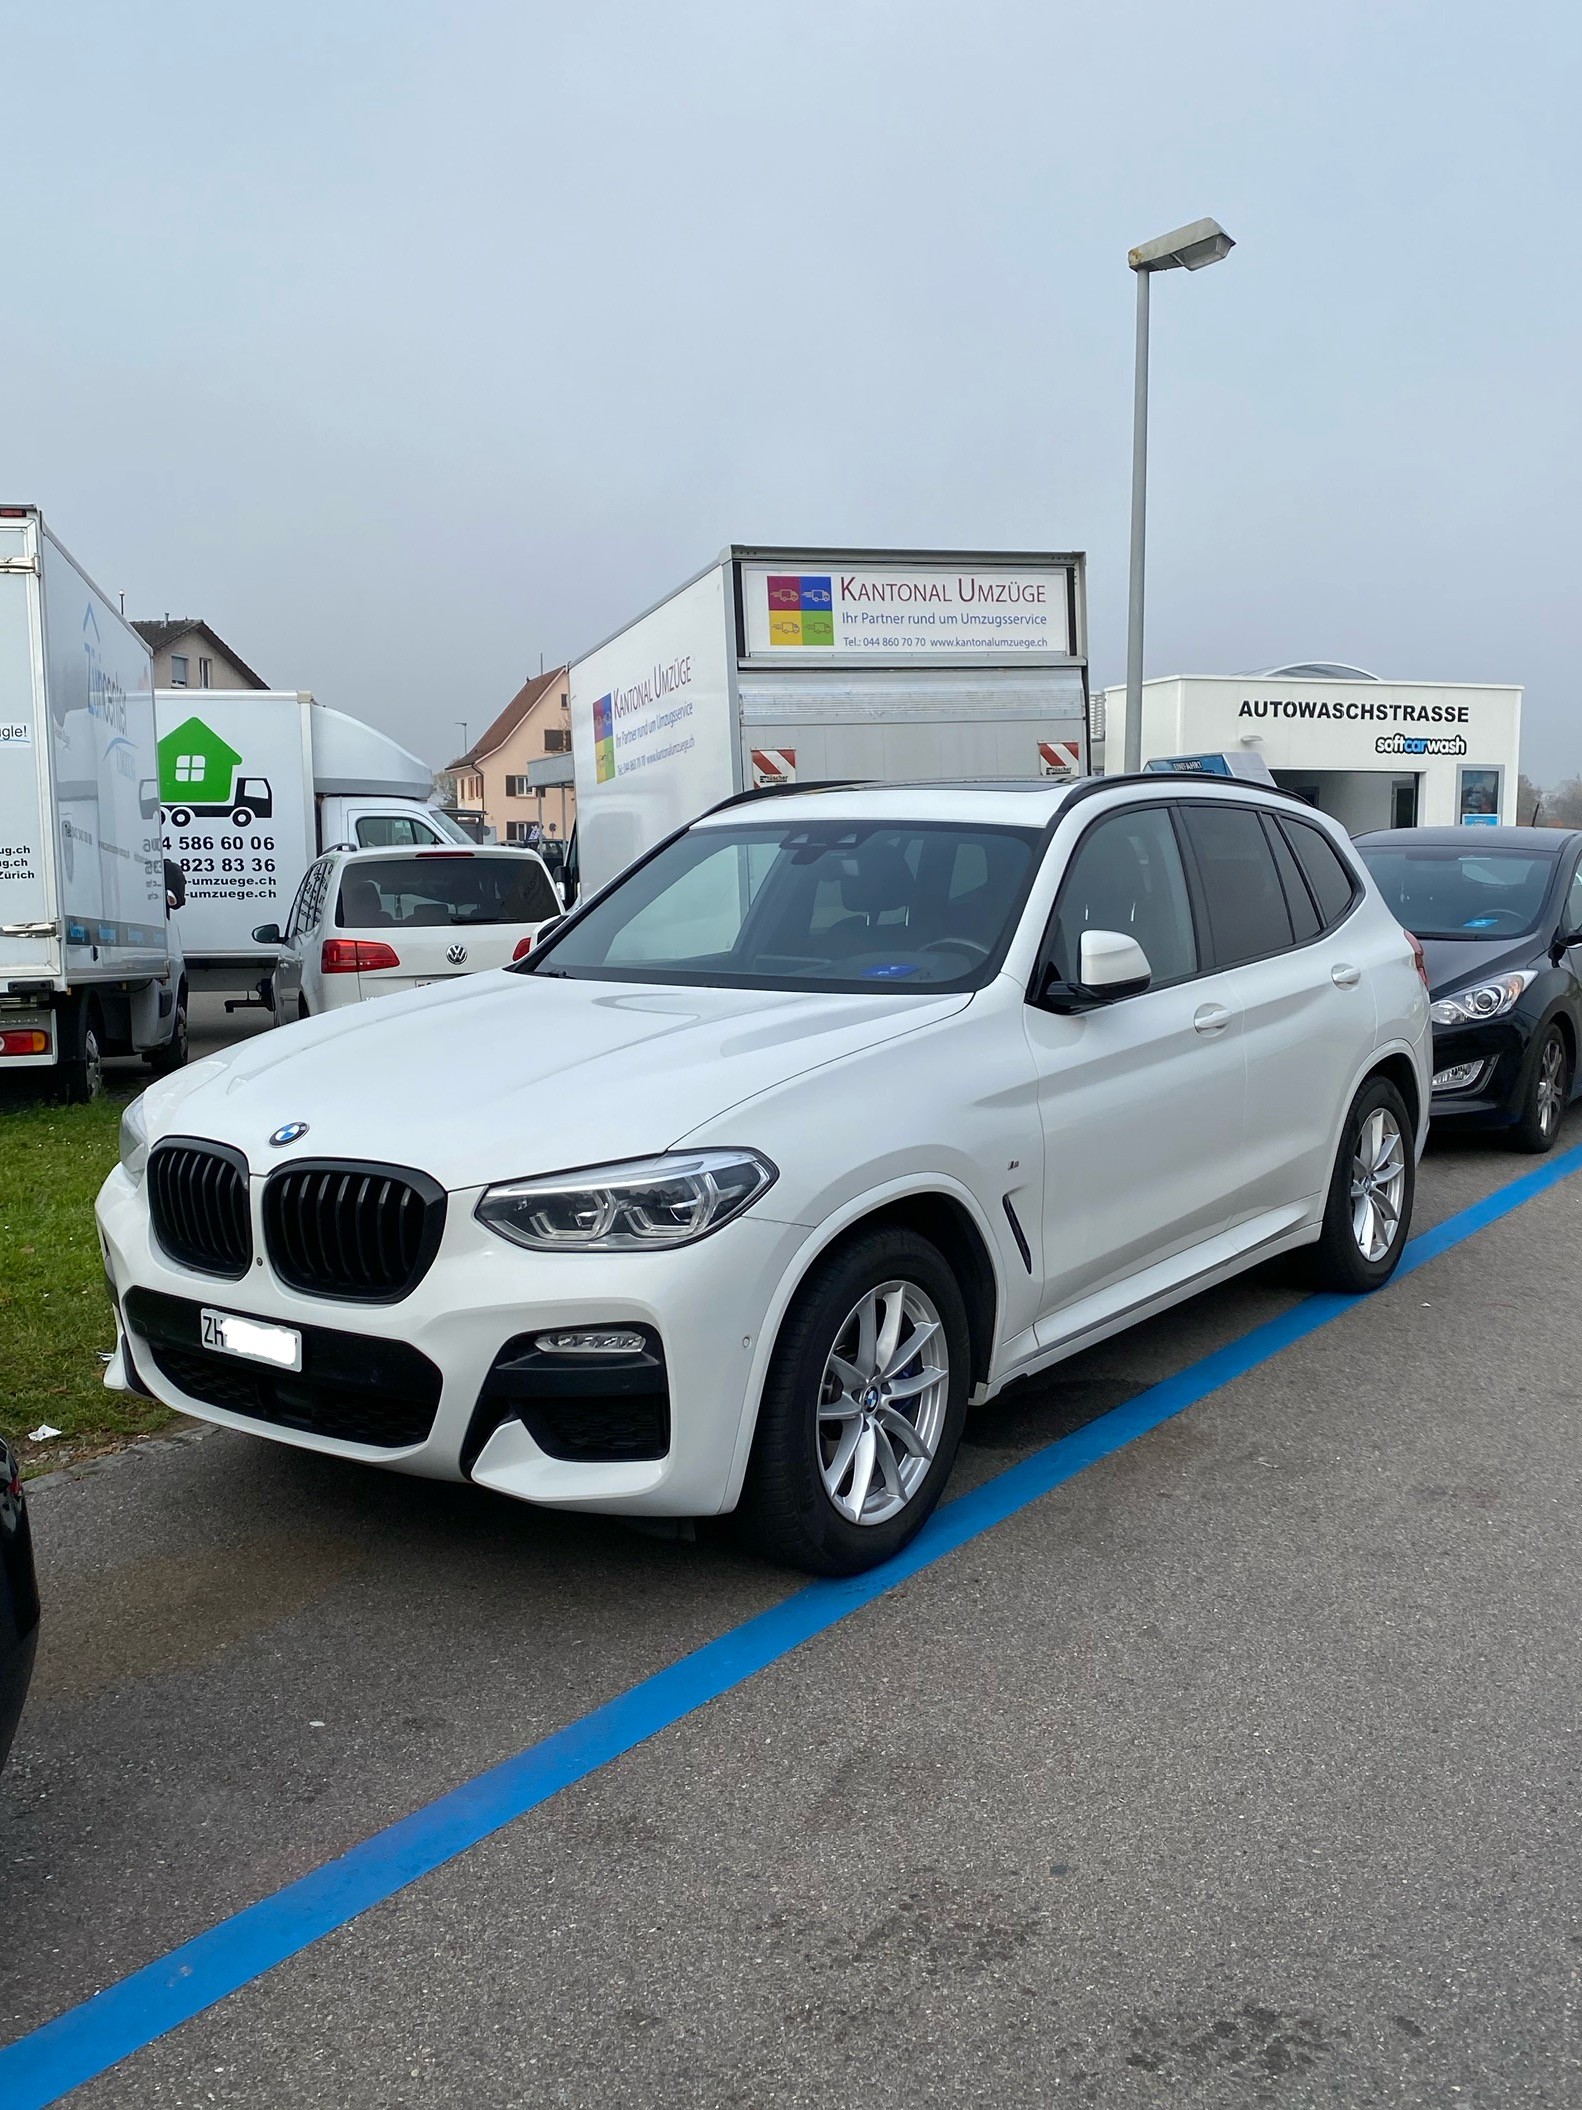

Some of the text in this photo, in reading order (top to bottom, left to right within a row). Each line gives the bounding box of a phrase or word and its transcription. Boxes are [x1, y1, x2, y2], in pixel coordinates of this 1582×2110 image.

[840, 576, 1047, 603] KANTONAL UMZÜGE
[842, 611, 1047, 628] Ihr Partner rund um Umzugsservice
[863, 637, 881, 647] 044
[882, 637, 900, 647] 860
[901, 637, 913, 647] 70
[915, 637, 926, 647] 70
[930, 636, 1048, 649] www.kantonalumzuege.ch
[613, 678, 653, 720] KANTONAL
[1238, 700, 1470, 723] AUTOWASCHSTRASSE
[0, 725, 27, 741] gle!
[1375, 733, 1467, 755] softcarwash
[179, 836, 214, 850] 586
[220, 836, 244, 850] 60
[250, 836, 275, 850] 06
[0, 858, 28, 869] g.ch
[180, 858, 276, 872] 823 83 36
[186, 876, 277, 888] -umzuege.ch
[186, 889, 277, 901] -umzuege.ch
